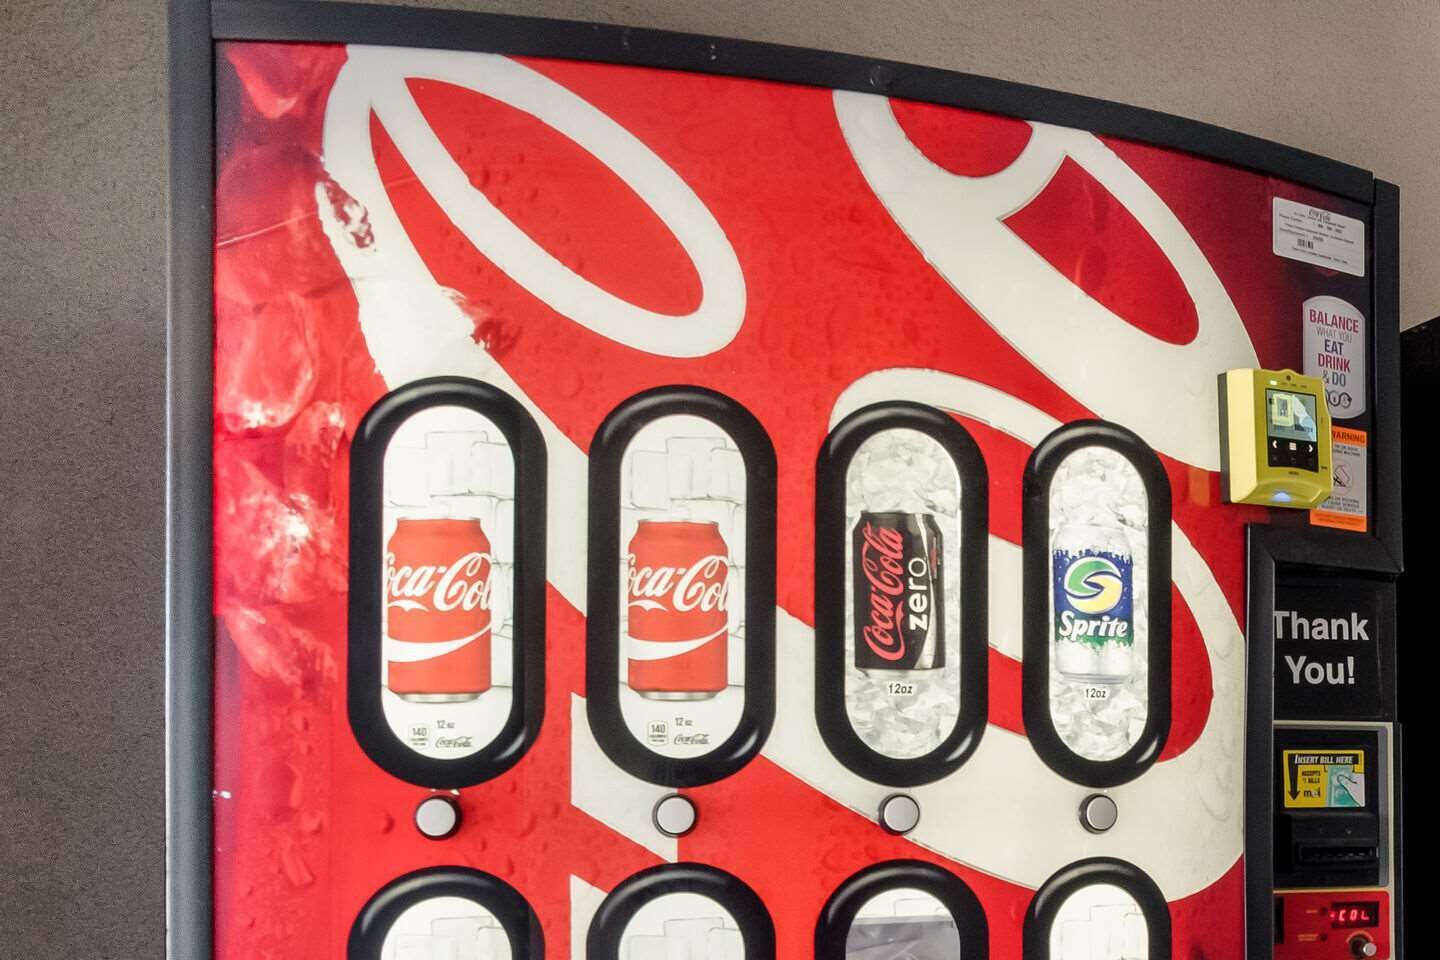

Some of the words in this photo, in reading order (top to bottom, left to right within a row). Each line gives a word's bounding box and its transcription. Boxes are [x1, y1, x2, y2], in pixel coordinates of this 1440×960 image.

[1309, 309, 1360, 333] BALANCE
[1316, 327, 1336, 338] WHAT
[1324, 339, 1344, 356] EAT
[1318, 353, 1351, 373] DRINK
[1332, 372, 1346, 387] DO
[907, 556, 929, 632] zero
[1058, 610, 1128, 643] Sprite
[1273, 610, 1370, 641] Thank
[1284, 655, 1355, 686] You!
